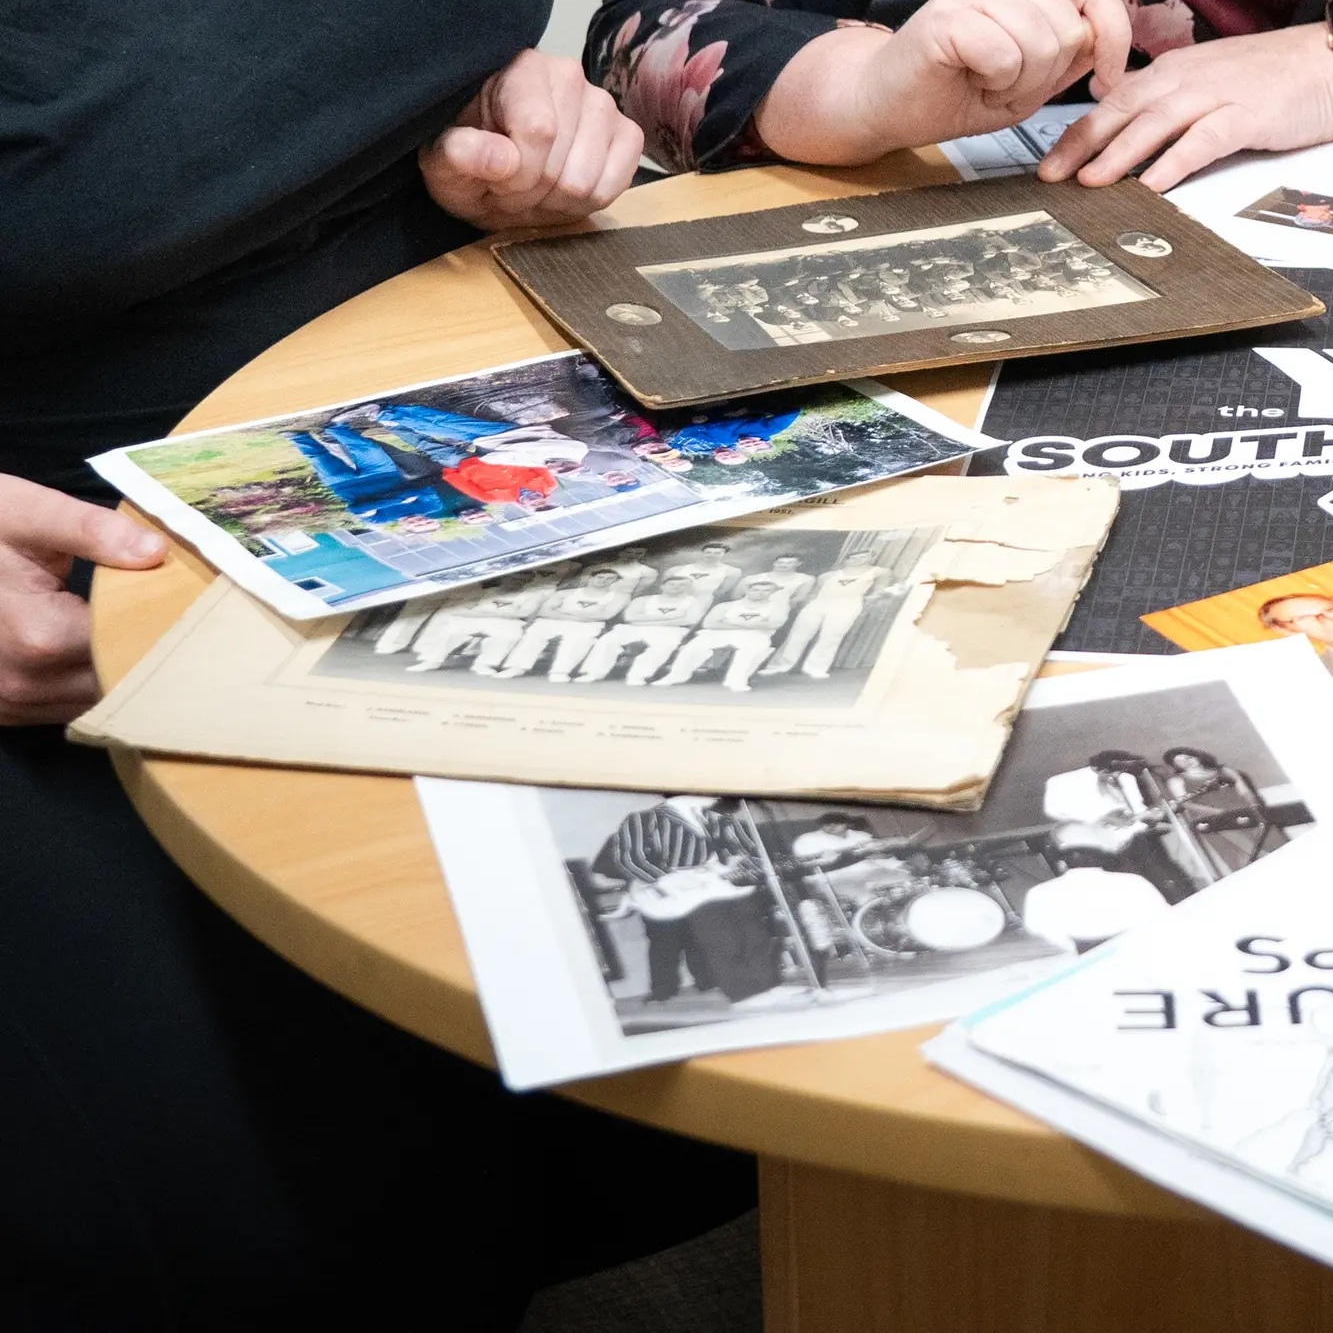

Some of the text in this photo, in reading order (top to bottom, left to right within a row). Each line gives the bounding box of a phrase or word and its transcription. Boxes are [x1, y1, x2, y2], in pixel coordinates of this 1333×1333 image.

[1218, 405, 1285, 419] the
[1121, 468, 1177, 478] KIDS,
[1184, 462, 1272, 473] STRONG
